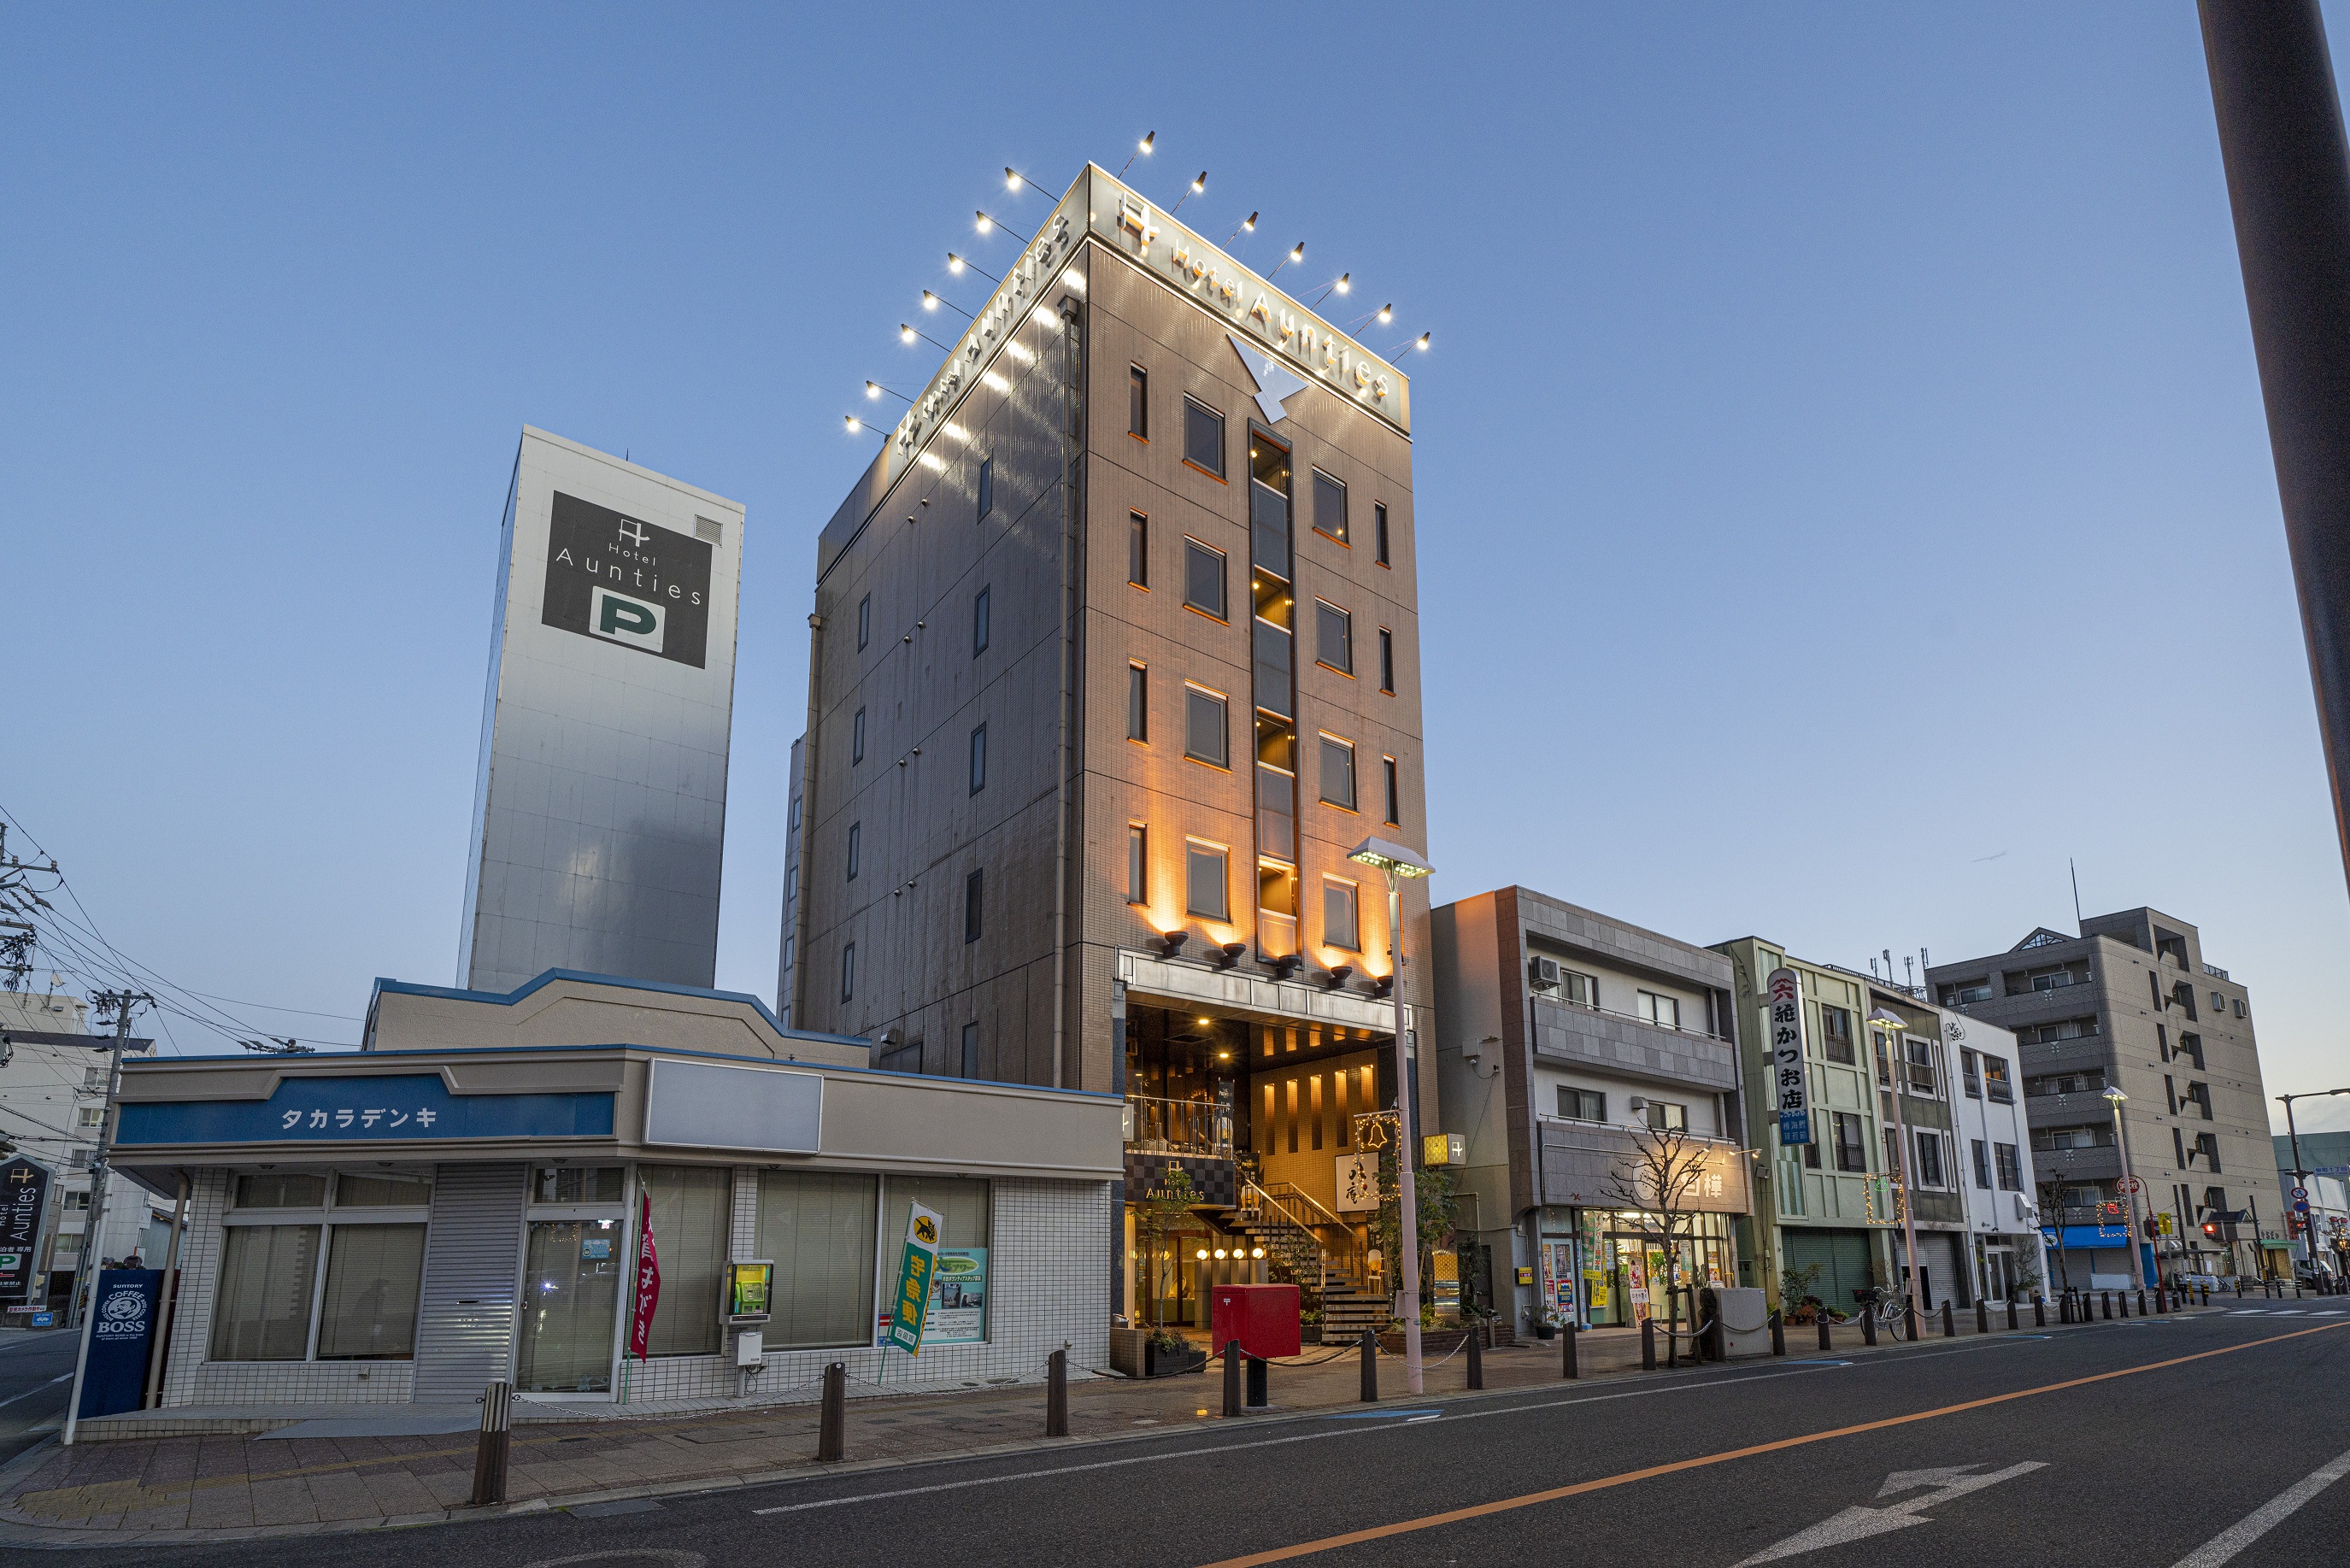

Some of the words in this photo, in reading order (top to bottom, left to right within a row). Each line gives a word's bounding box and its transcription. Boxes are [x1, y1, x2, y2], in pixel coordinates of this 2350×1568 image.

[965, 214, 1068, 362] Aunties
[1172, 239, 1243, 303] Hotel
[1251, 291, 1389, 399] Aunties
[608, 543, 655, 567] Hotel
[555, 548, 701, 605] Aunties
[599, 594, 657, 635] P
[282, 1107, 437, 1130] タカラデンキ
[1146, 1188, 1204, 1201] Aunties
[10, 1187, 36, 1241] Aunties
[109, 1290, 144, 1300] COFFEE
[97, 1320, 145, 1333] BOSS
